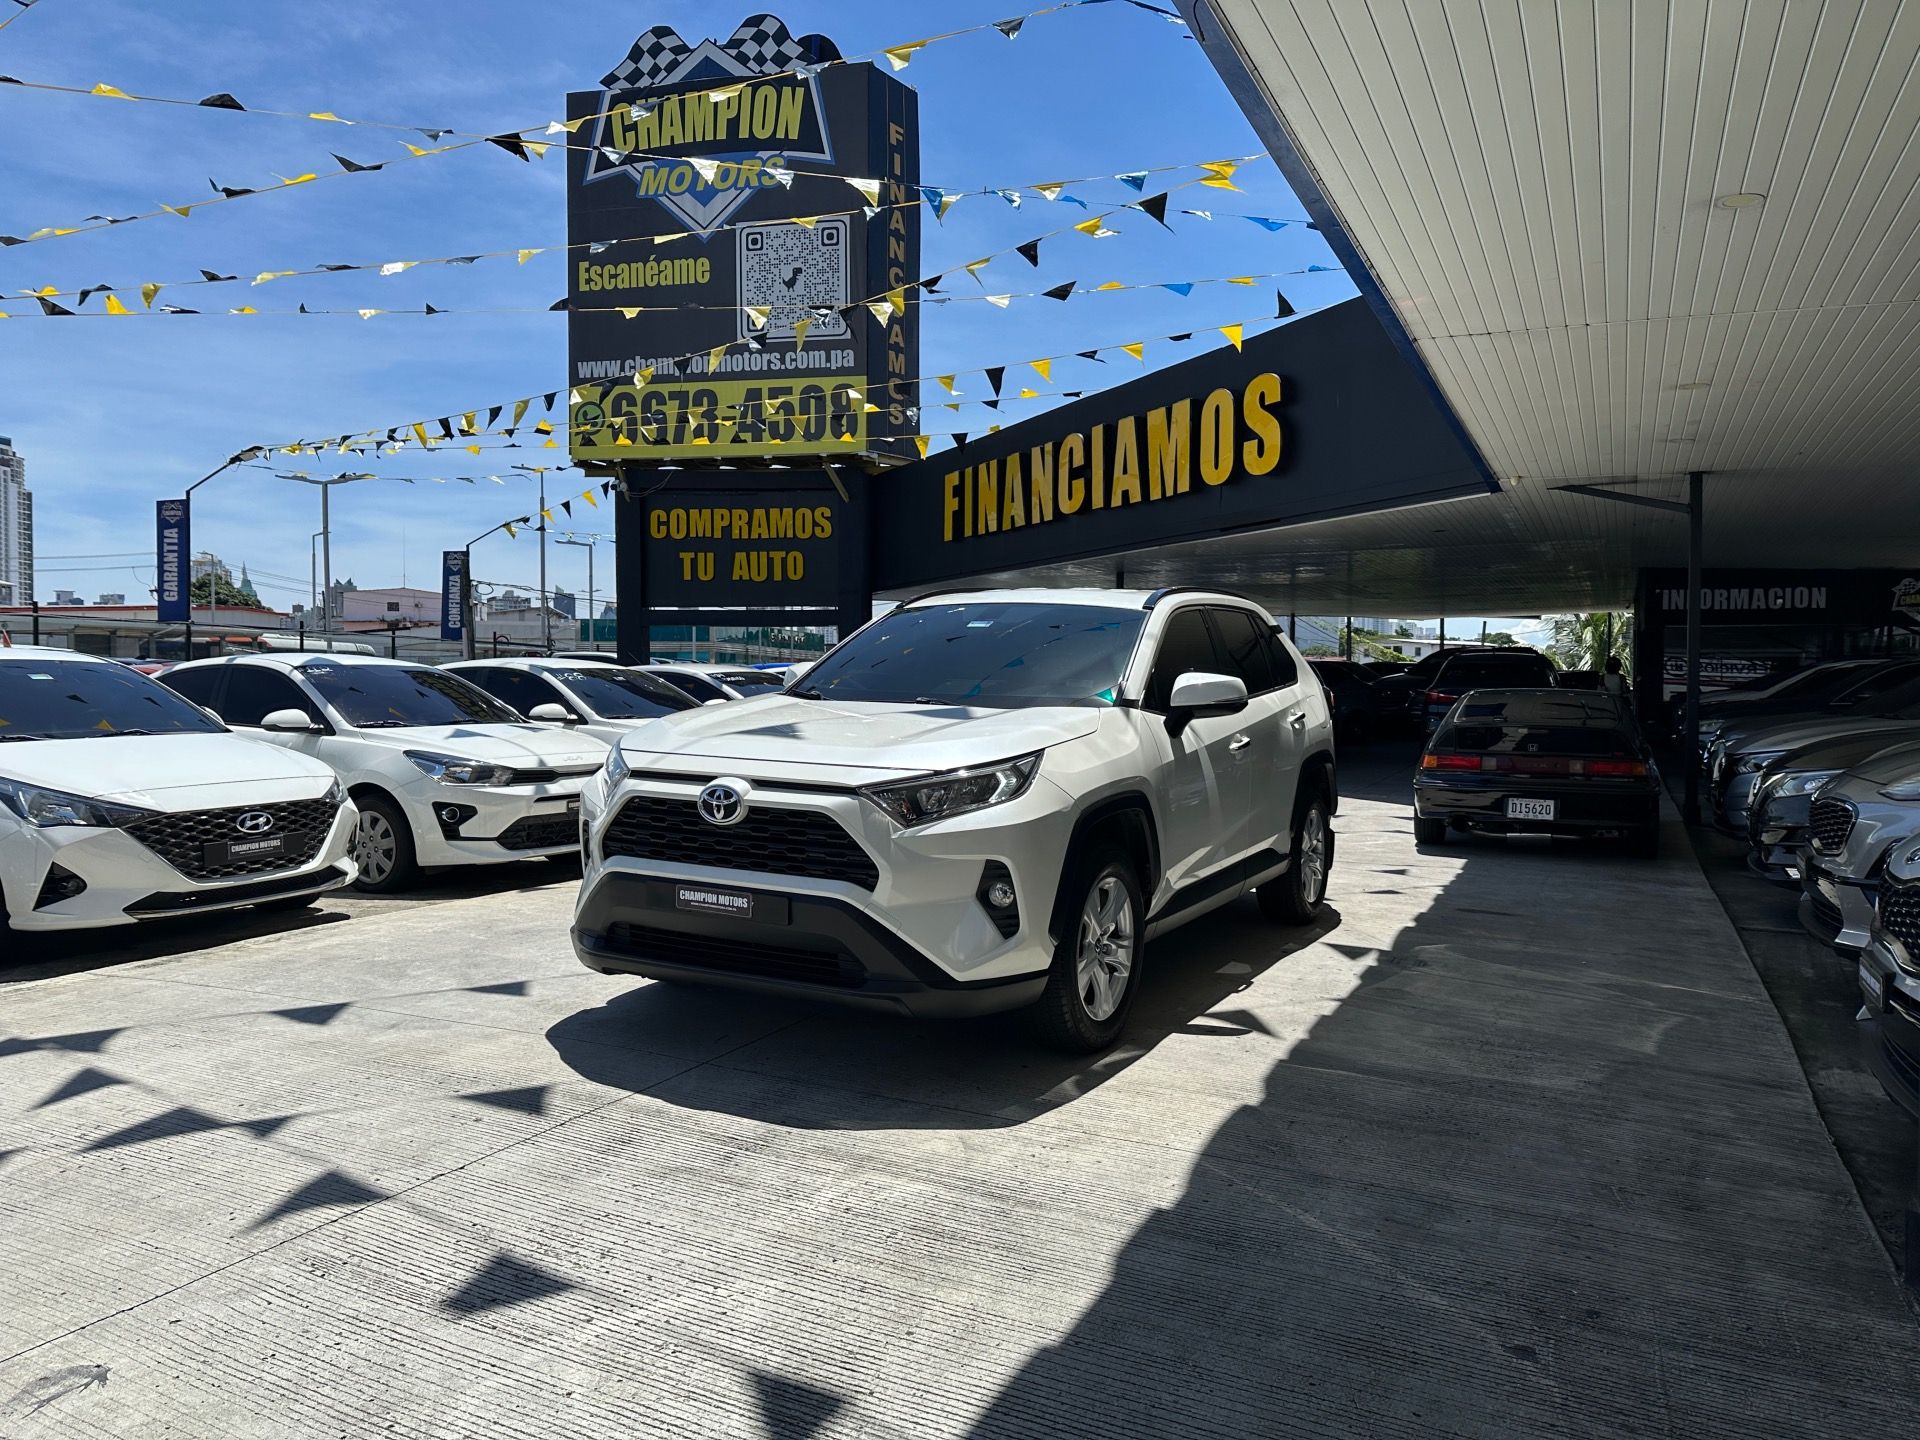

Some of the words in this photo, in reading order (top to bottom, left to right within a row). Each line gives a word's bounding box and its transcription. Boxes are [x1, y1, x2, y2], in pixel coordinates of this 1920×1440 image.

[611, 85, 805, 153] CHAMPION
[578, 254, 711, 292] Escanéame
[888, 122, 905, 425] FINANCAMOS
[943, 373, 1283, 542] FINANCIAMOS
[650, 506, 833, 540] COMPRAMOS
[163, 527, 179, 602] GARANTIA
[679, 552, 714, 581] TU
[732, 551, 804, 582] AUTO
[448, 574, 461, 629] CONFIANZA
[1662, 586, 1827, 610] INORMACION
[1511, 802, 1551, 815] DI5620
[231, 842, 259, 852] CHAMPION
[680, 890, 717, 903] CHAMPION
[718, 894, 748, 908] MOTORS
